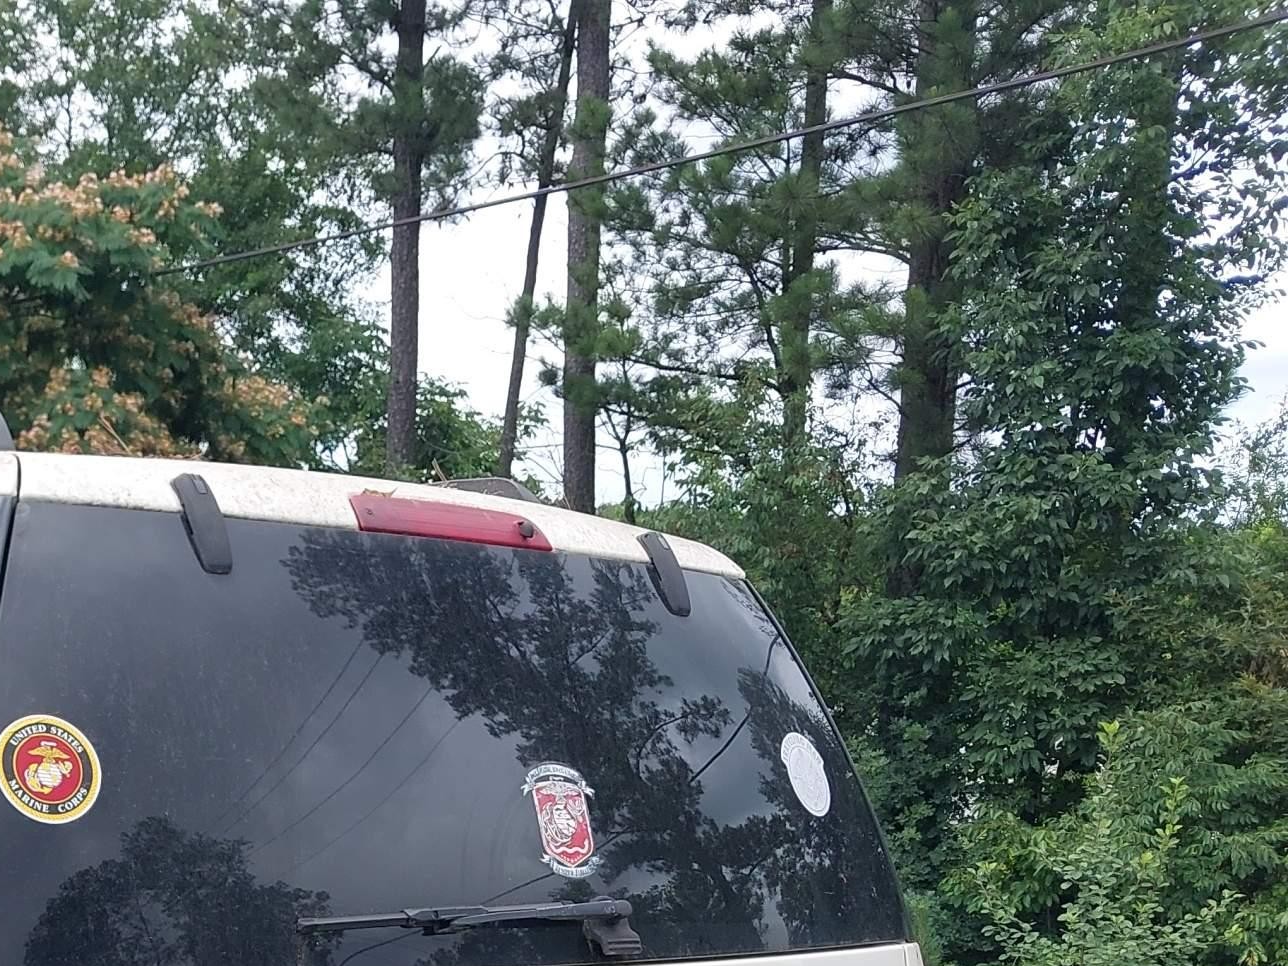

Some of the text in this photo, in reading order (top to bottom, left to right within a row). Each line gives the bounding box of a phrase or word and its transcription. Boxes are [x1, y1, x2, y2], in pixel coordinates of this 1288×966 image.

[10, 724, 84, 753] UNITED STATES
[9, 779, 88, 813] MARINE CORPS
